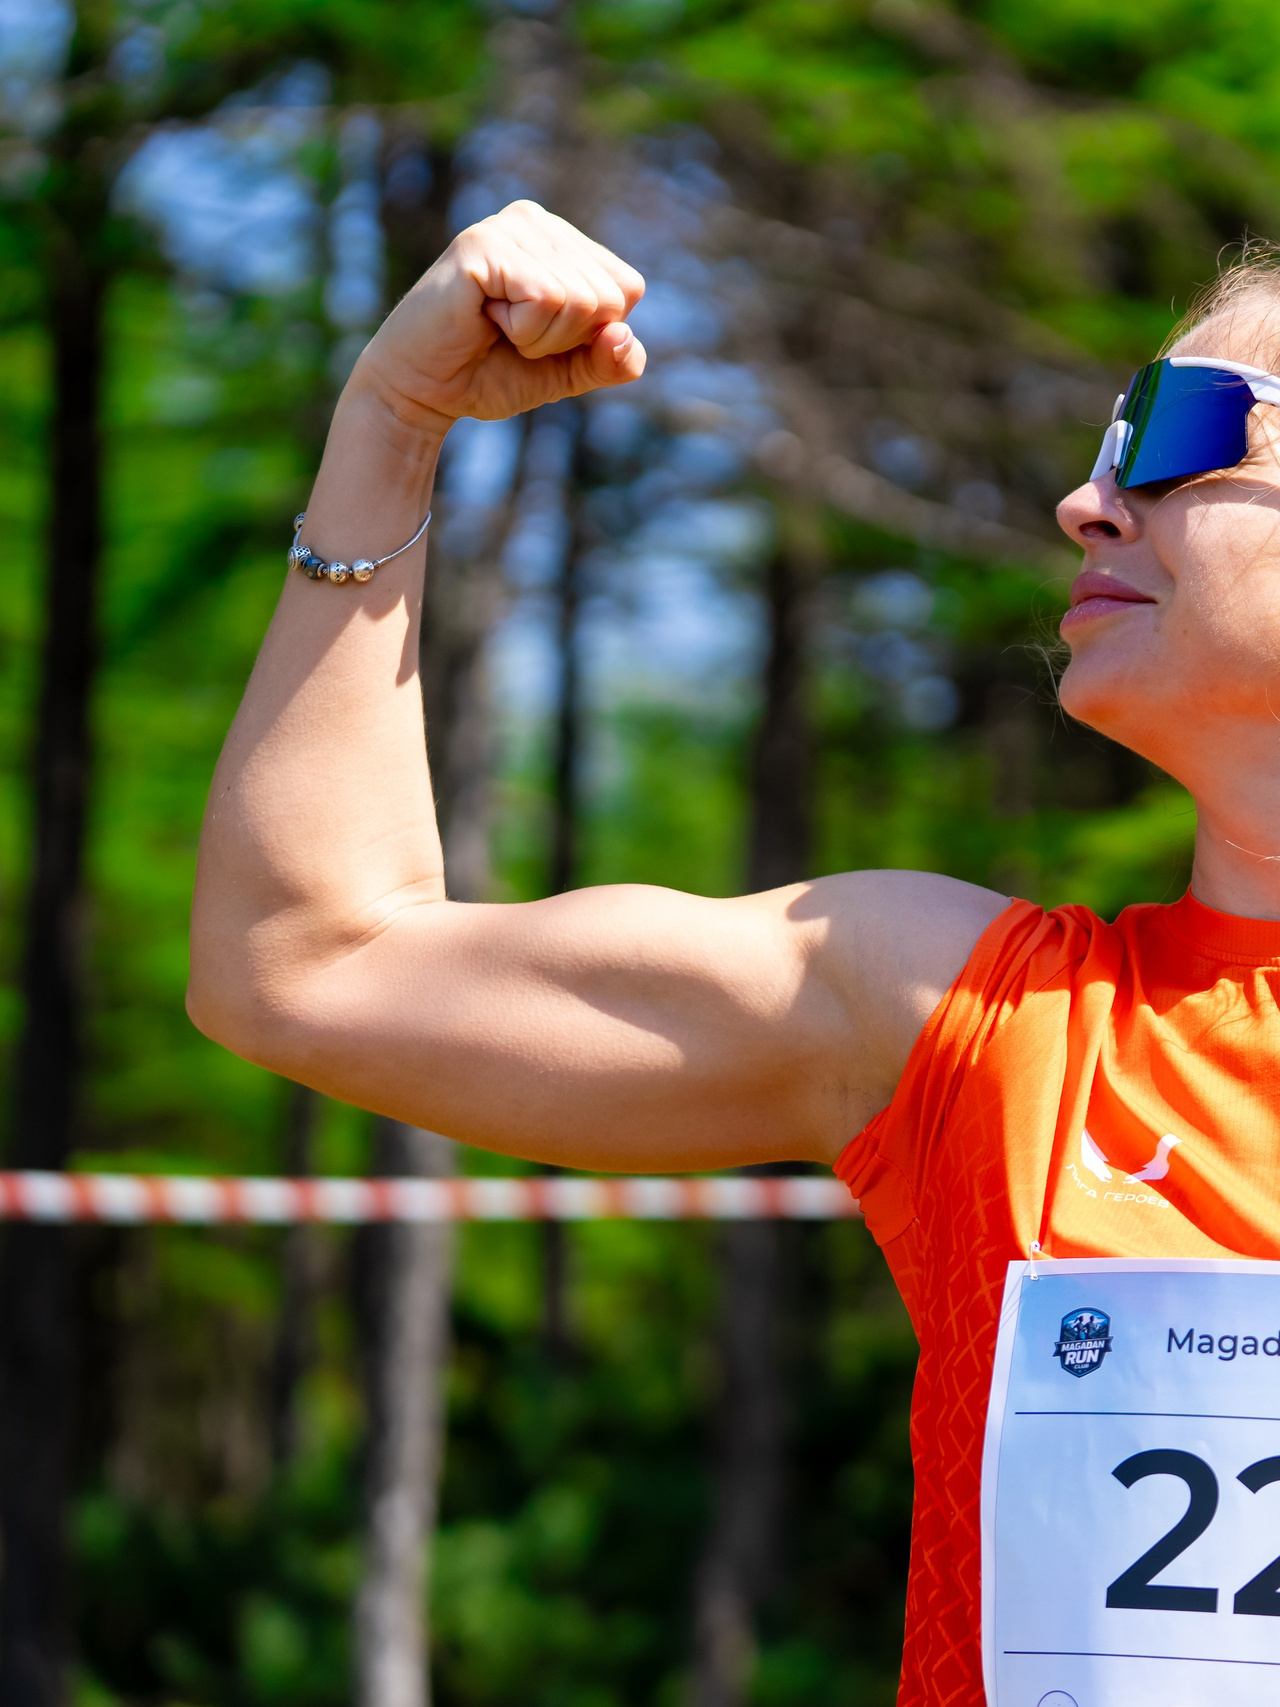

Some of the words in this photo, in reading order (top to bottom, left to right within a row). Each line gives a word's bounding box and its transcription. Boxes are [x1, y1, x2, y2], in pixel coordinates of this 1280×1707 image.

[1065, 1163, 1097, 1198] ЛИГА
[1103, 1191, 1170, 1208] ГЕРОЕВ
[1061, 1340, 1105, 1352] MAGADAN
[1065, 1349, 1099, 1365] RUN
